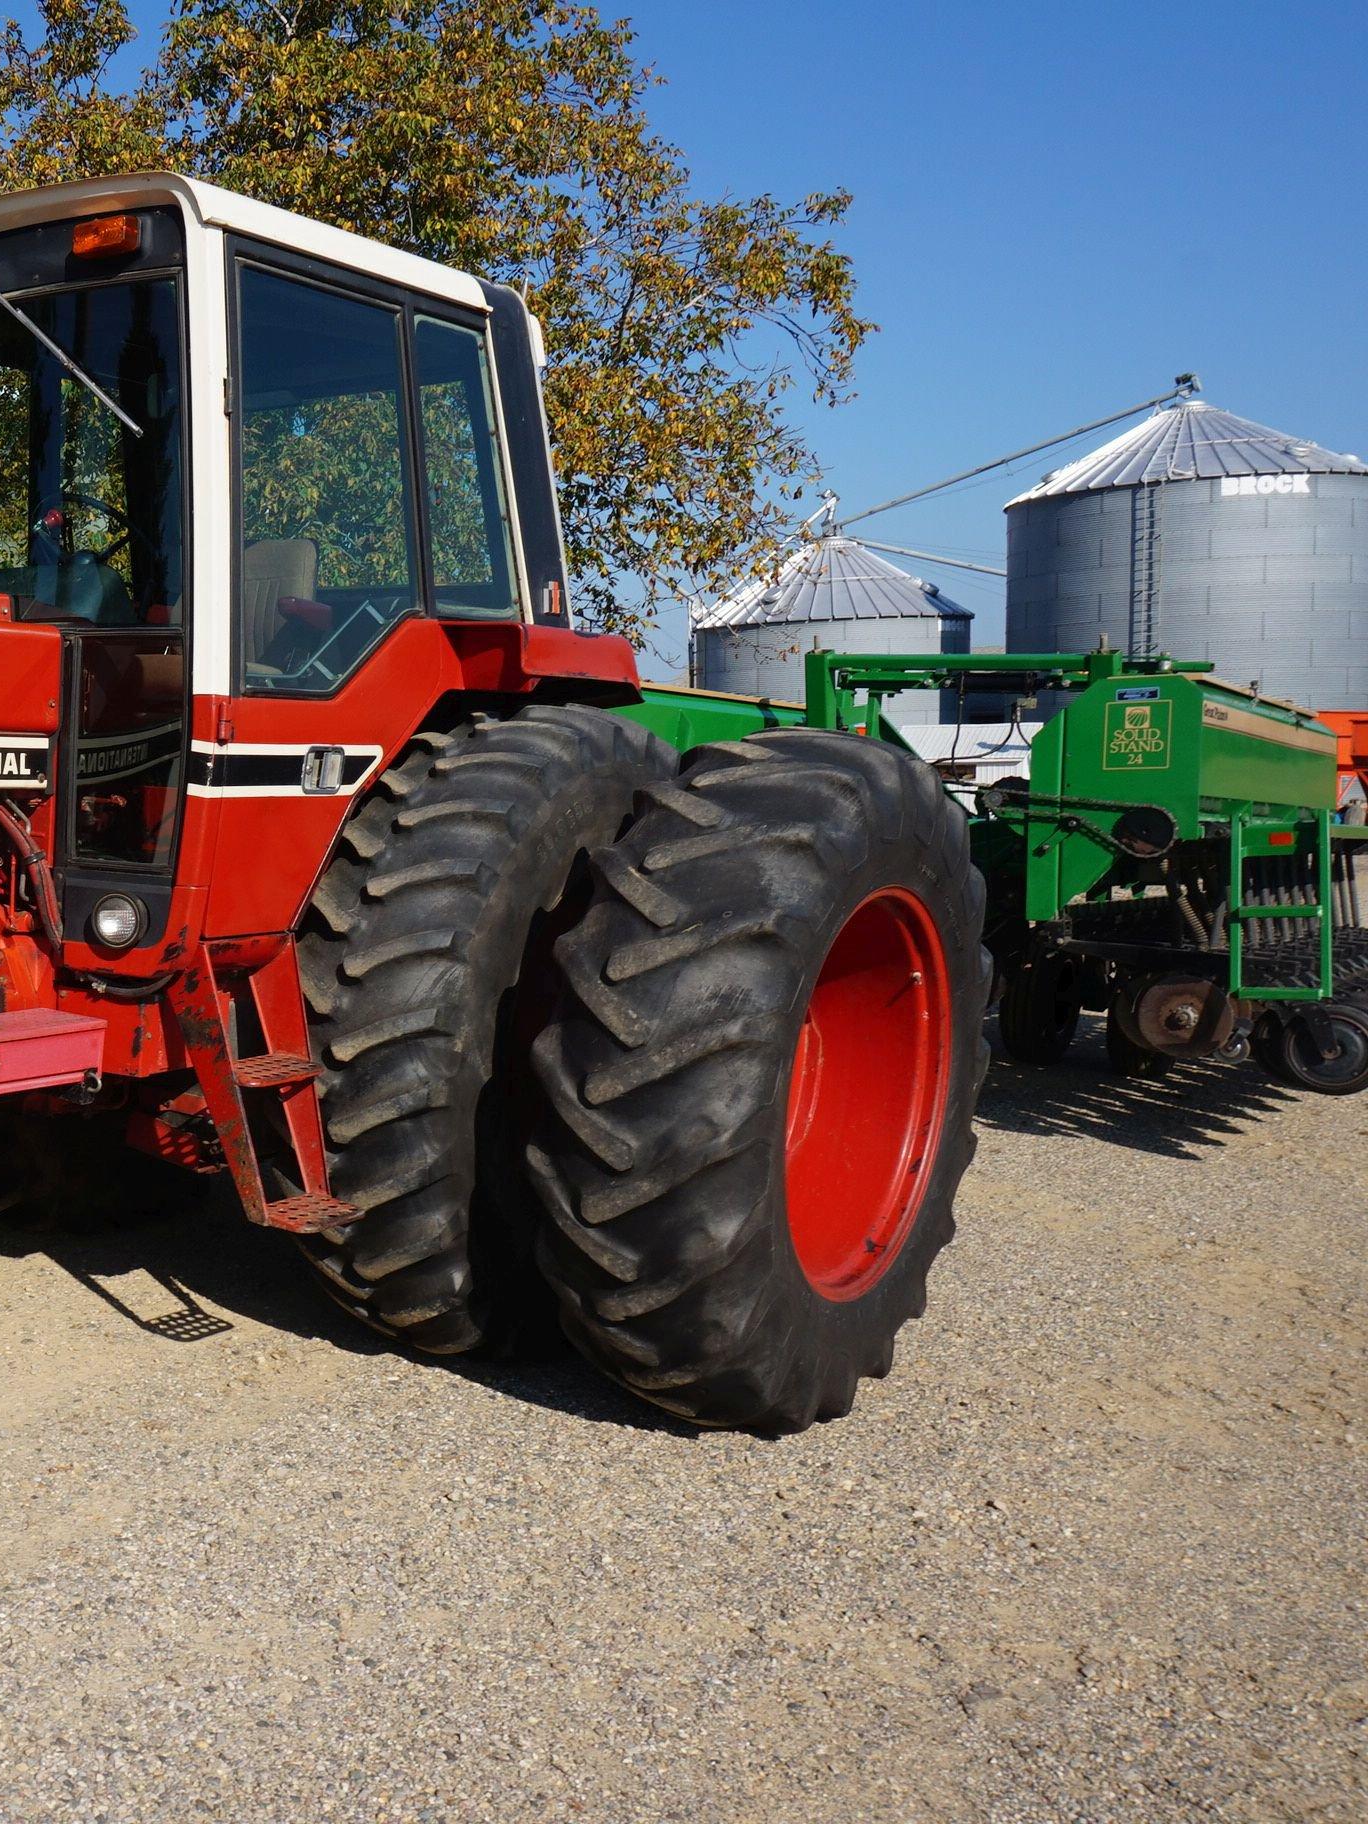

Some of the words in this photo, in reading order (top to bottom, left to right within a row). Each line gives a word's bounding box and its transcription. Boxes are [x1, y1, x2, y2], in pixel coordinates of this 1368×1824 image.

[1220, 474, 1311, 497] BROCK
[1113, 728, 1161, 742] SOLID
[1109, 740, 1164, 753] STAND
[1127, 753, 1143, 765] 24
